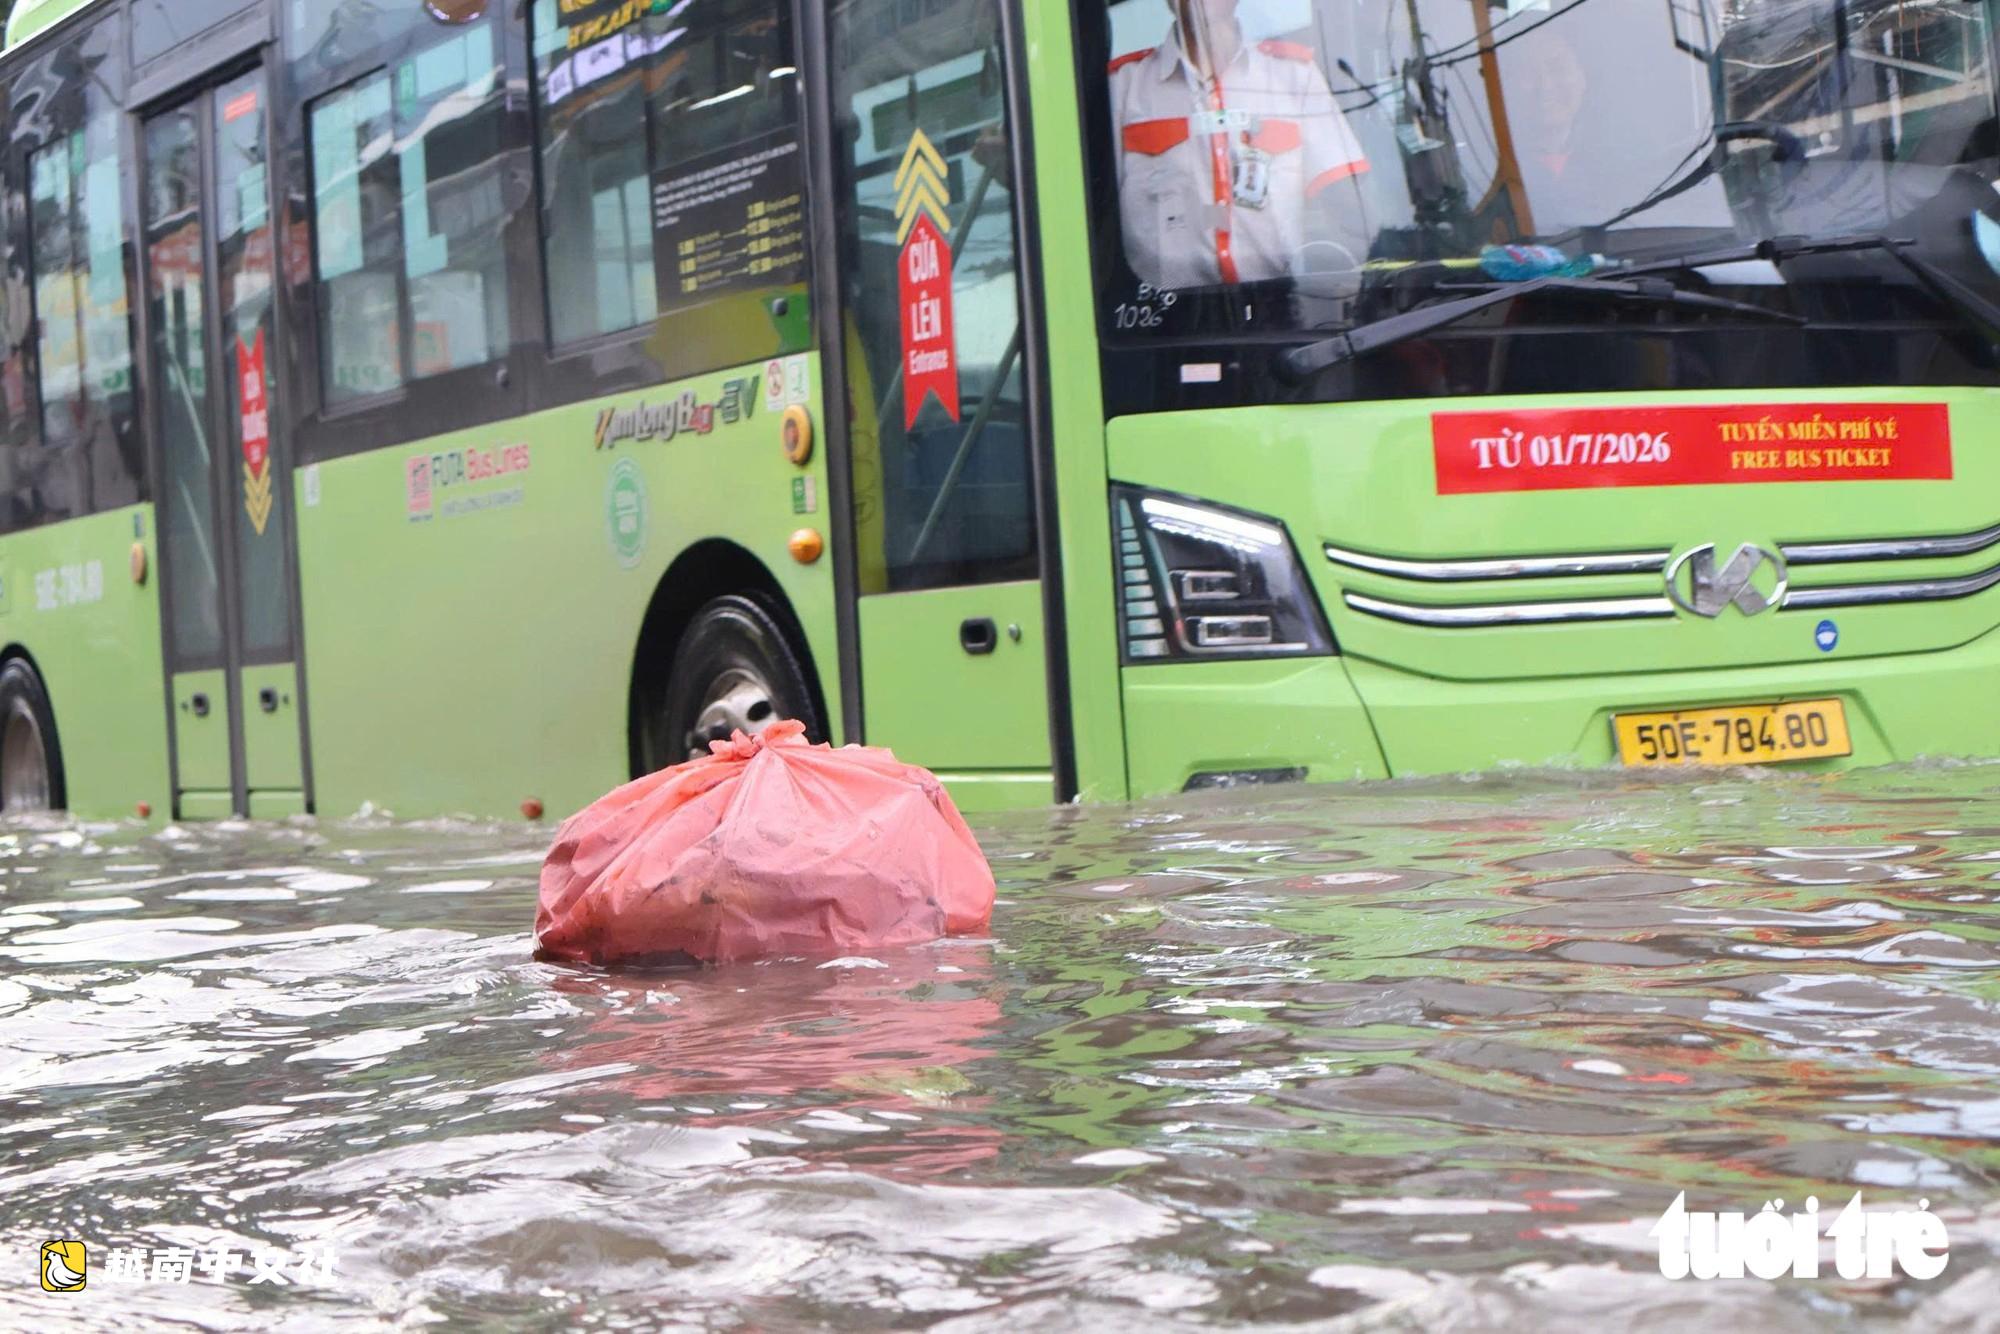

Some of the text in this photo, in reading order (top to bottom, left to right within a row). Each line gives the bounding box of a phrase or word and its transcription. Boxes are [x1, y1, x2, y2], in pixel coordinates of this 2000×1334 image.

[911, 289, 942, 341] LÊN
[909, 348, 949, 375] Entrance
[1840, 416, 1871, 440] PHÍ
[1471, 427, 1671, 469] TỪ 01/7/2026
[1732, 448, 1893, 469] FREE BUS TICKET
[432, 452, 464, 486] FUTA
